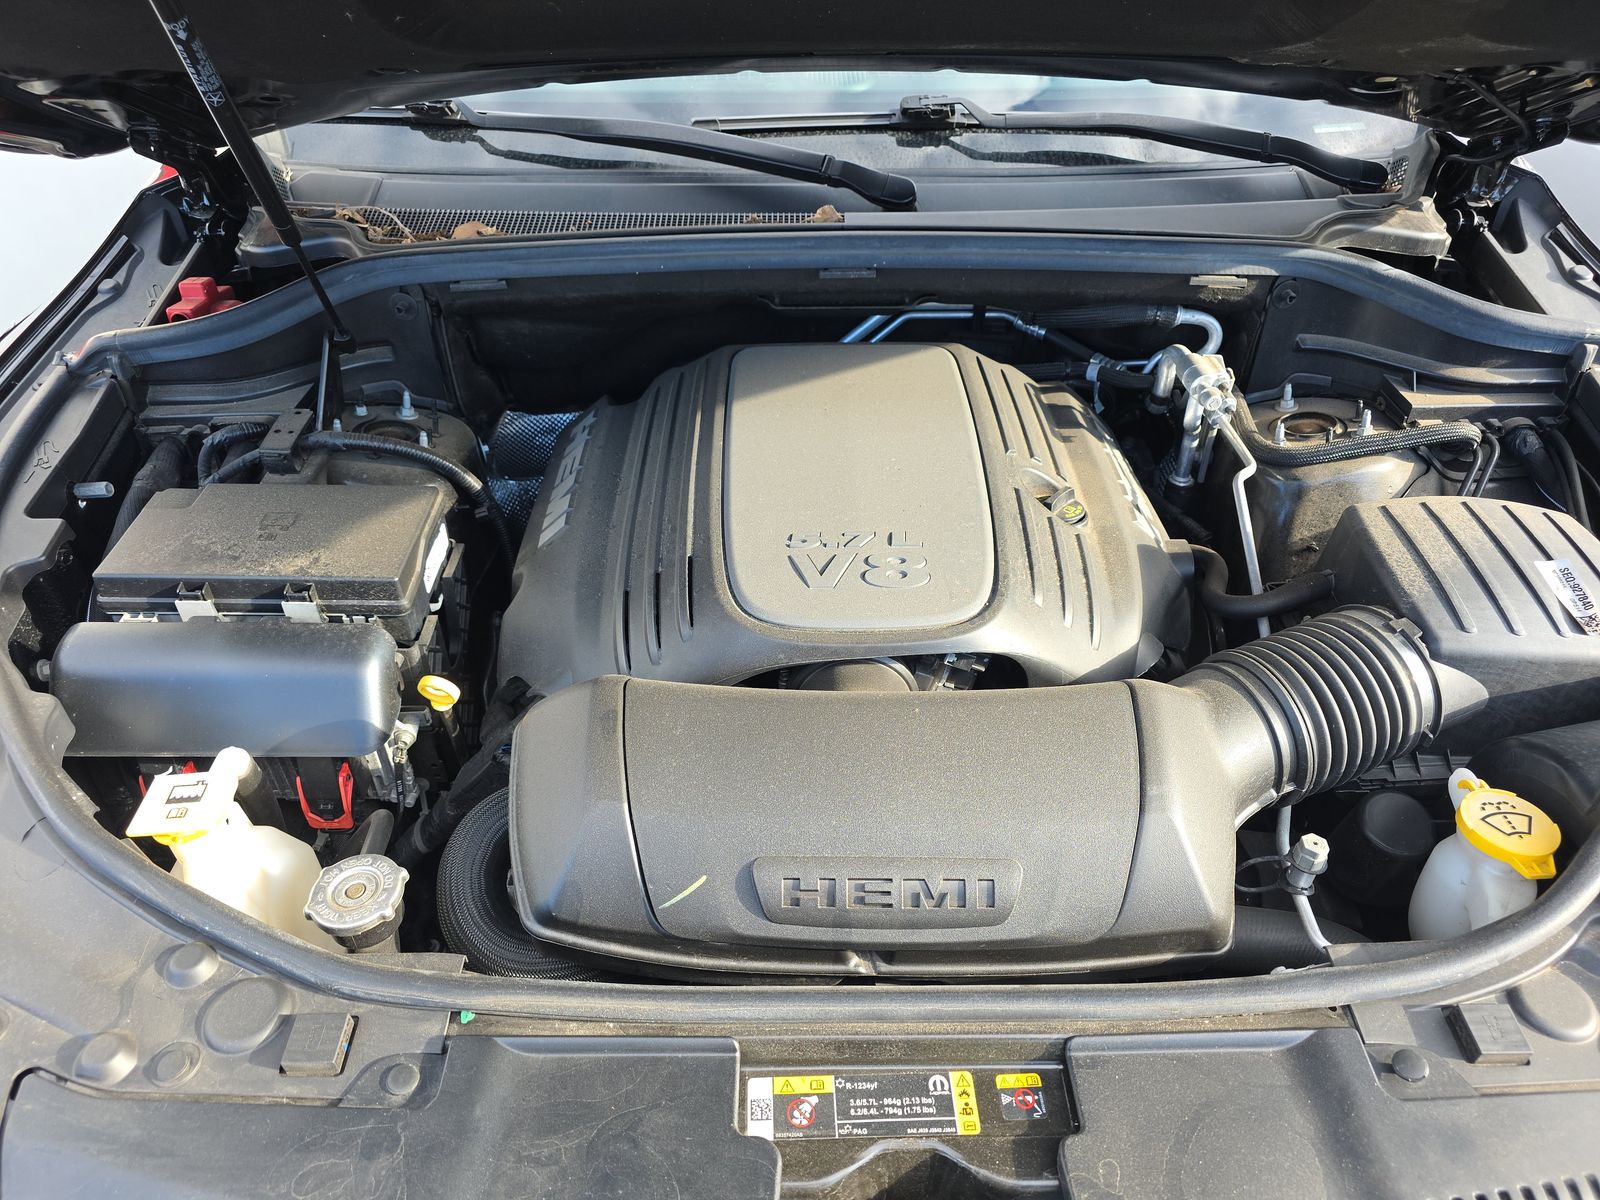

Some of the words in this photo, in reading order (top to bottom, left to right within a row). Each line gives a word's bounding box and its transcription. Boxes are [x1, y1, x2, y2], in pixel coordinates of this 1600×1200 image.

[538, 409, 598, 549] HEMI
[785, 530, 924, 548] 5.7L
[786, 552, 932, 589] V8
[341, 857, 373, 872] OPEN
[373, 860, 392, 877] NOT
[319, 868, 340, 886] HOT
[781, 877, 996, 909] HEMI
[845, 1081, 878, 1090] R-1234yf
[849, 1098, 878, 1106] 3.6/5.7L
[902, 1096, 920, 1106] (2.13
[921, 1096, 935, 1106] lbs)
[884, 1106, 903, 1116] 794g
[903, 1106, 921, 1115] (1.75
[922, 1105, 937, 1115] lbs)
